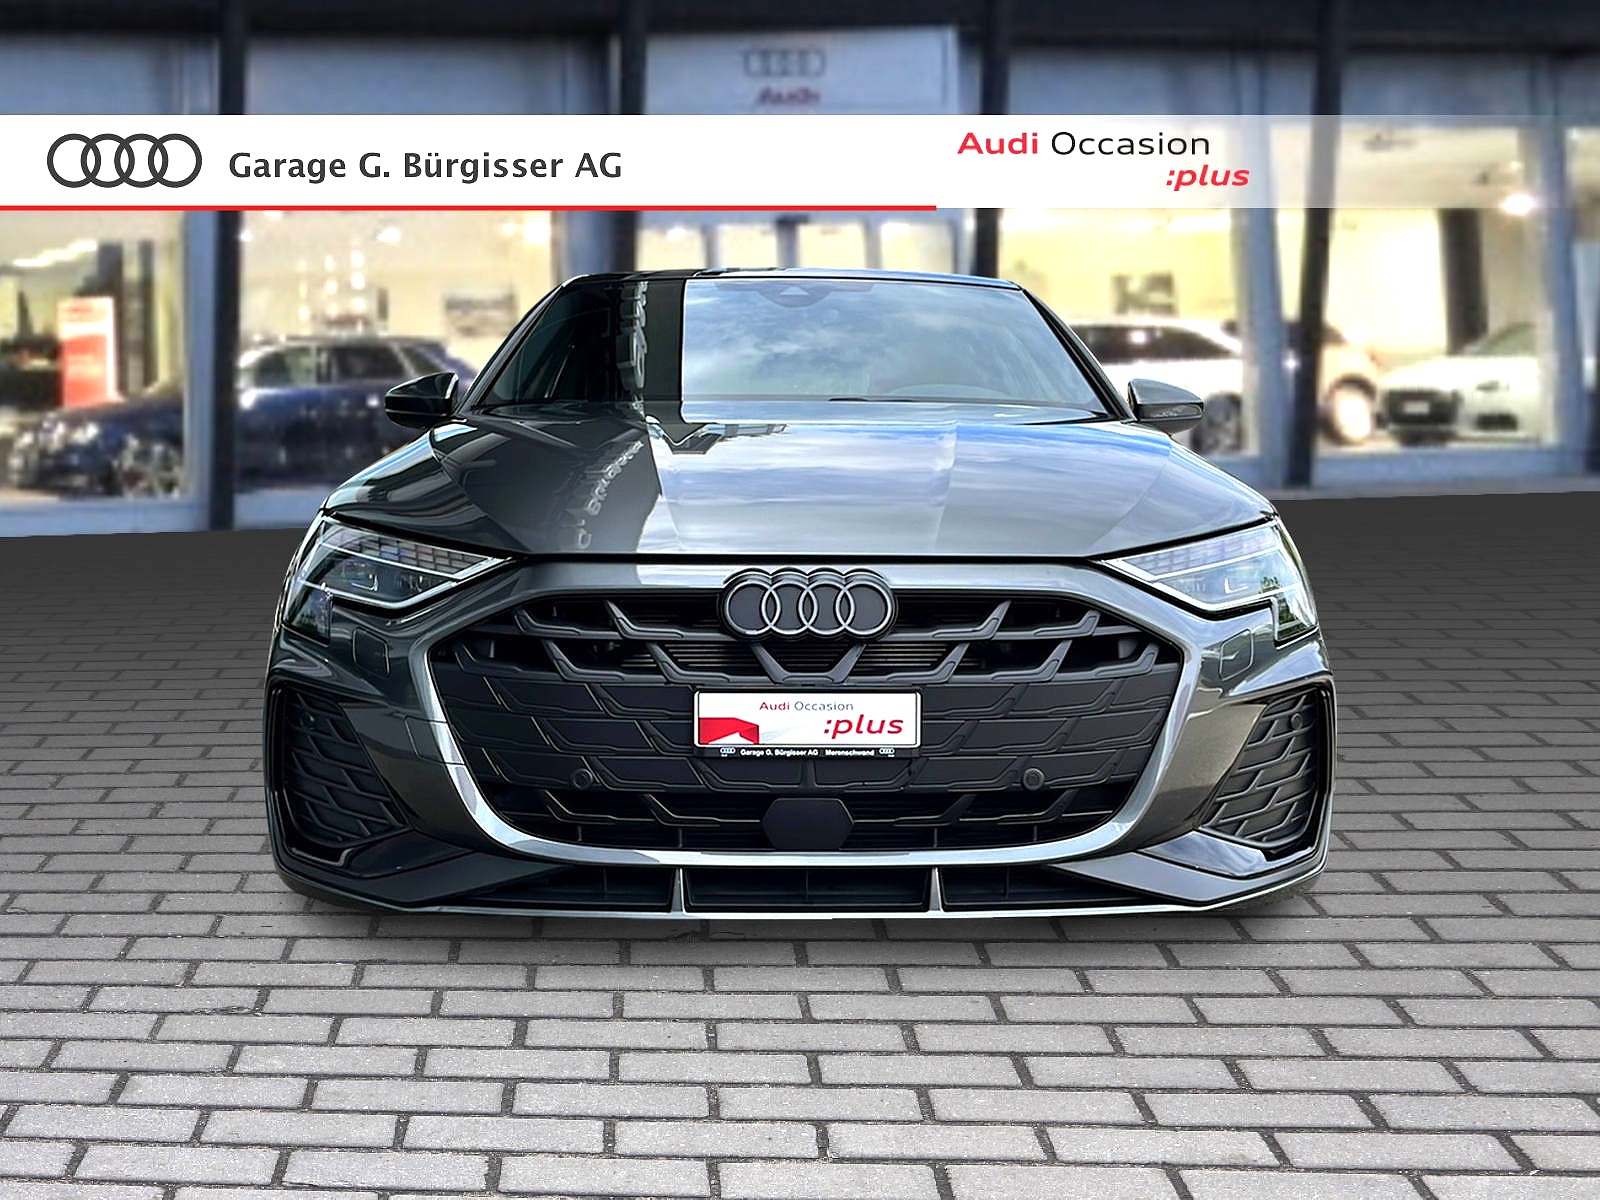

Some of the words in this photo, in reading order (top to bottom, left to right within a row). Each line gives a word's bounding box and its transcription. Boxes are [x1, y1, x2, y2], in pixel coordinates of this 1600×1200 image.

[759, 701, 790, 711] Audi
[793, 701, 854, 711] Occasion
[823, 713, 904, 740] :plus
